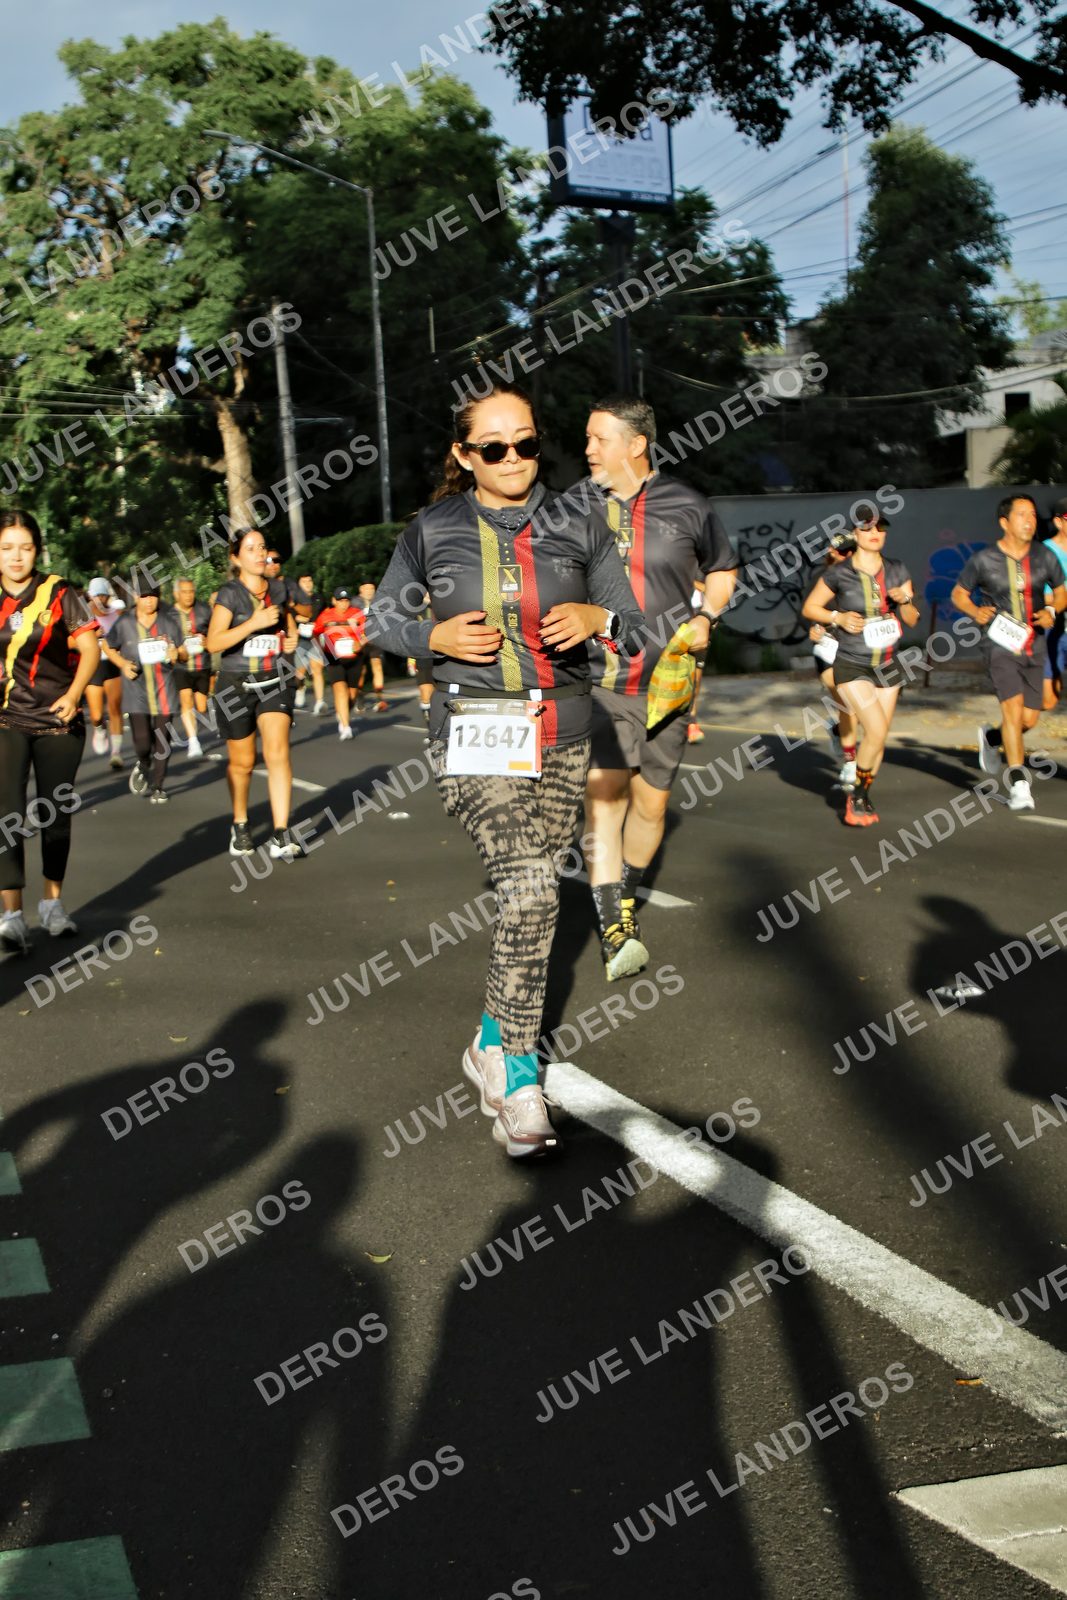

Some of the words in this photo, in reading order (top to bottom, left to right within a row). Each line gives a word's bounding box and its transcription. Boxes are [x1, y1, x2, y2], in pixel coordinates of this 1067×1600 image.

[738, 520, 795, 542] TOY
[868, 623, 896, 638] 11902
[455, 725, 530, 748] 12647
